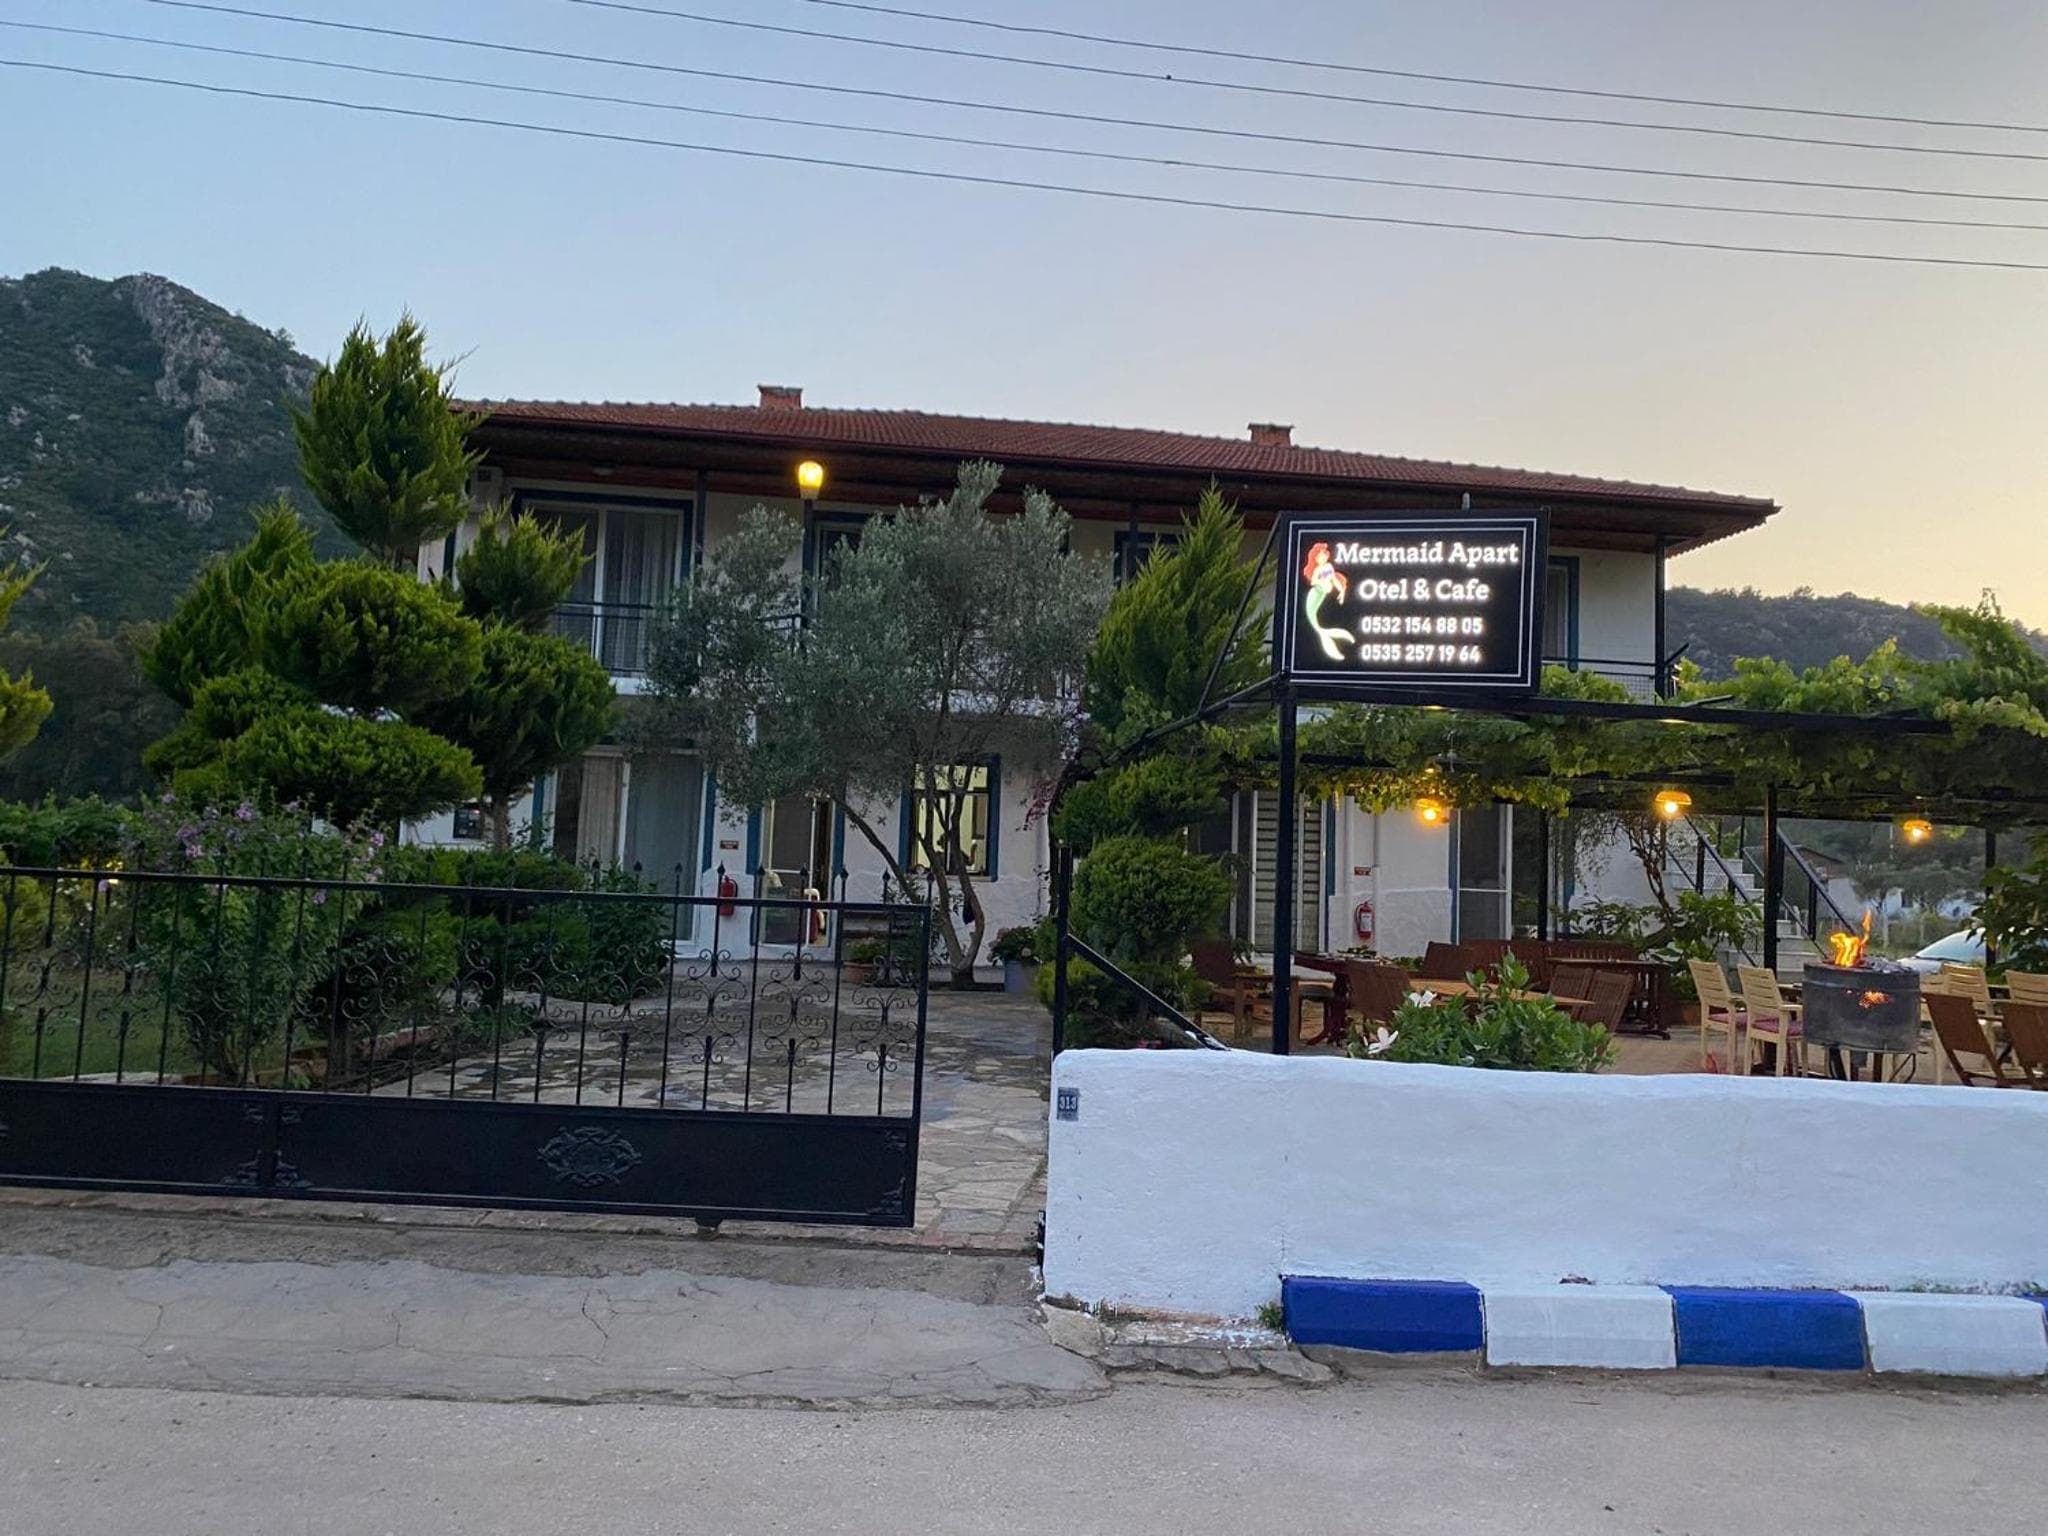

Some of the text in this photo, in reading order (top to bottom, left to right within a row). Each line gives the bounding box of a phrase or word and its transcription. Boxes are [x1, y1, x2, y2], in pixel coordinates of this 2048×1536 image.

[1335, 541, 1519, 569] Mermaid Apart
[1357, 578, 1490, 601] Otel & Cafe
[1361, 615, 1483, 635] 0532 154 88 05
[1360, 643, 1481, 664] 0535 257 19 64
